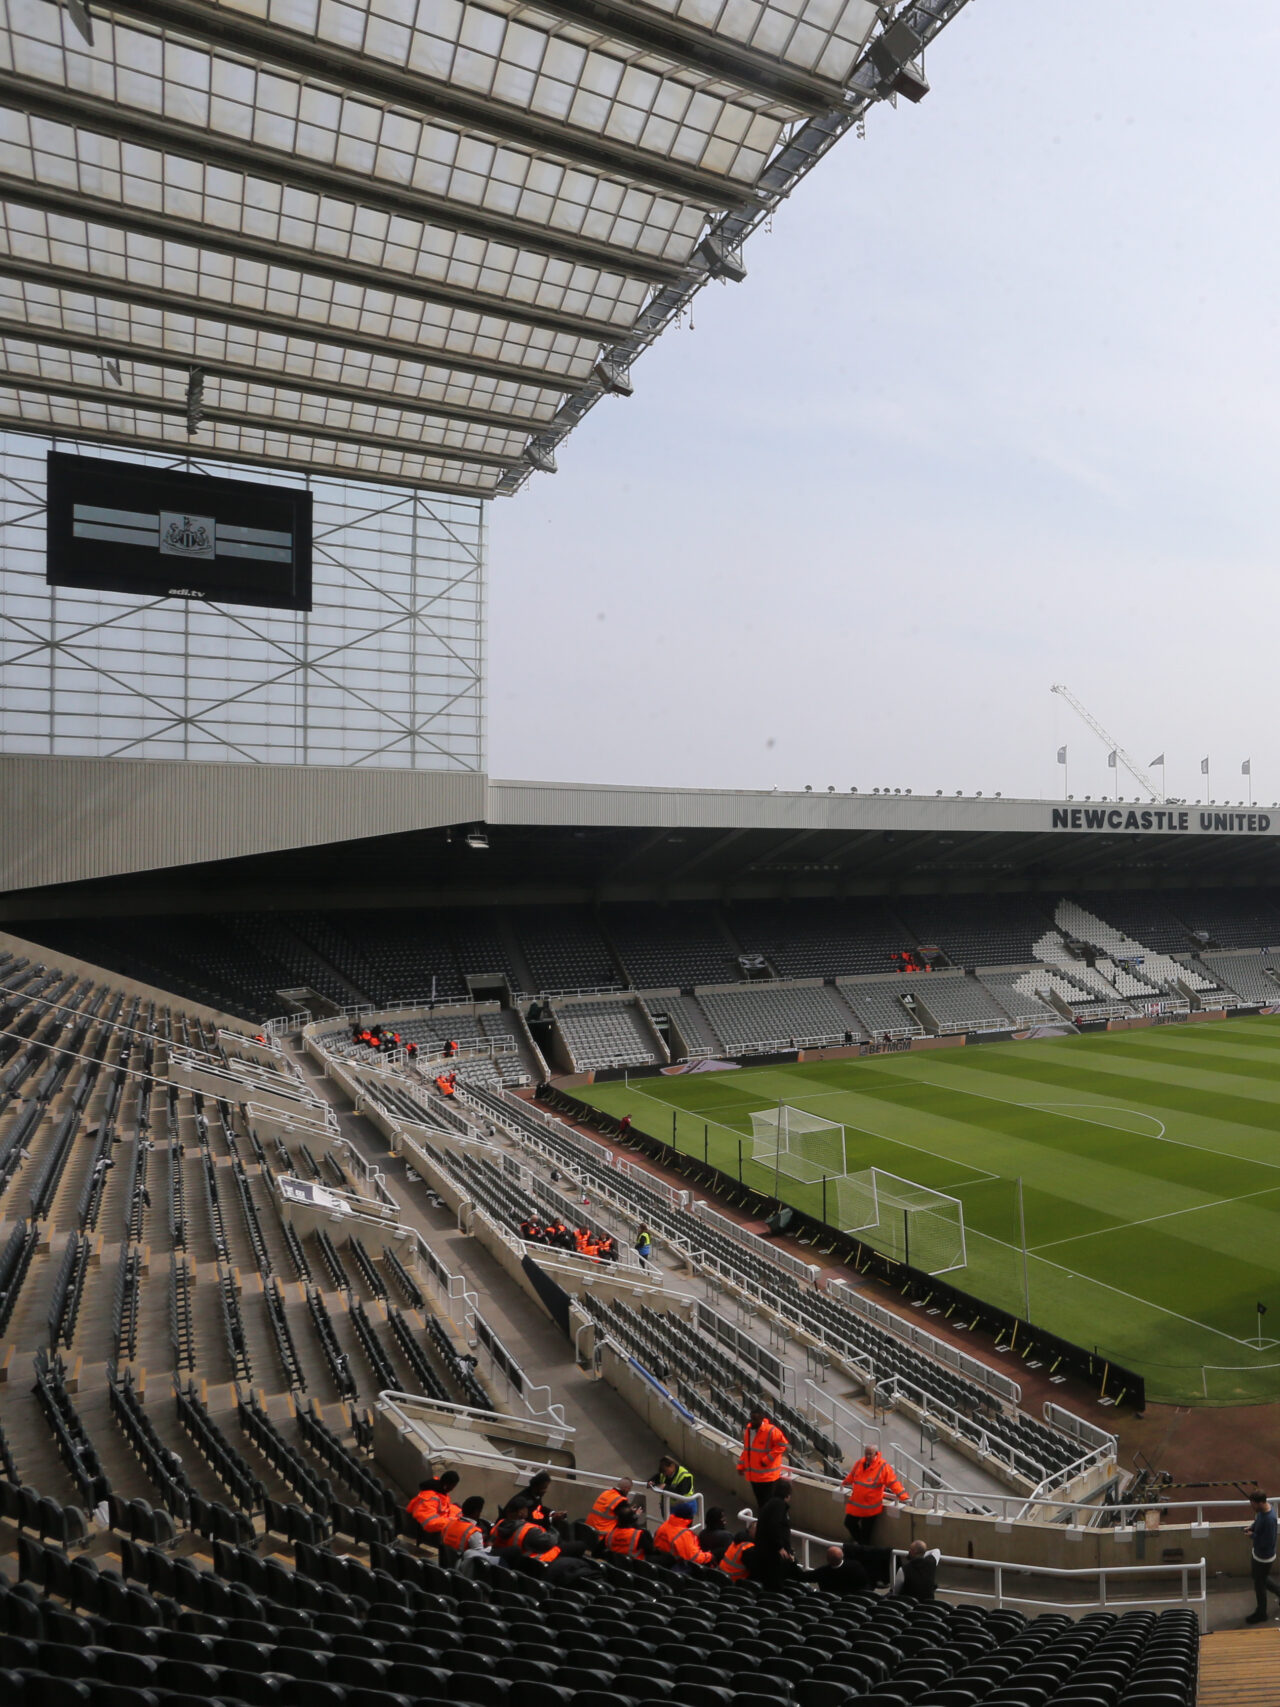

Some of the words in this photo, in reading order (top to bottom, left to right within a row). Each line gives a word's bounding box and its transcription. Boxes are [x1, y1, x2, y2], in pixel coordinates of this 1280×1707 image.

[168, 588, 205, 597] adi.tv
[1052, 808, 1188, 831] NEWCASTLE
[1200, 812, 1271, 832] UNITED
[868, 1041, 912, 1054] BETMGM
